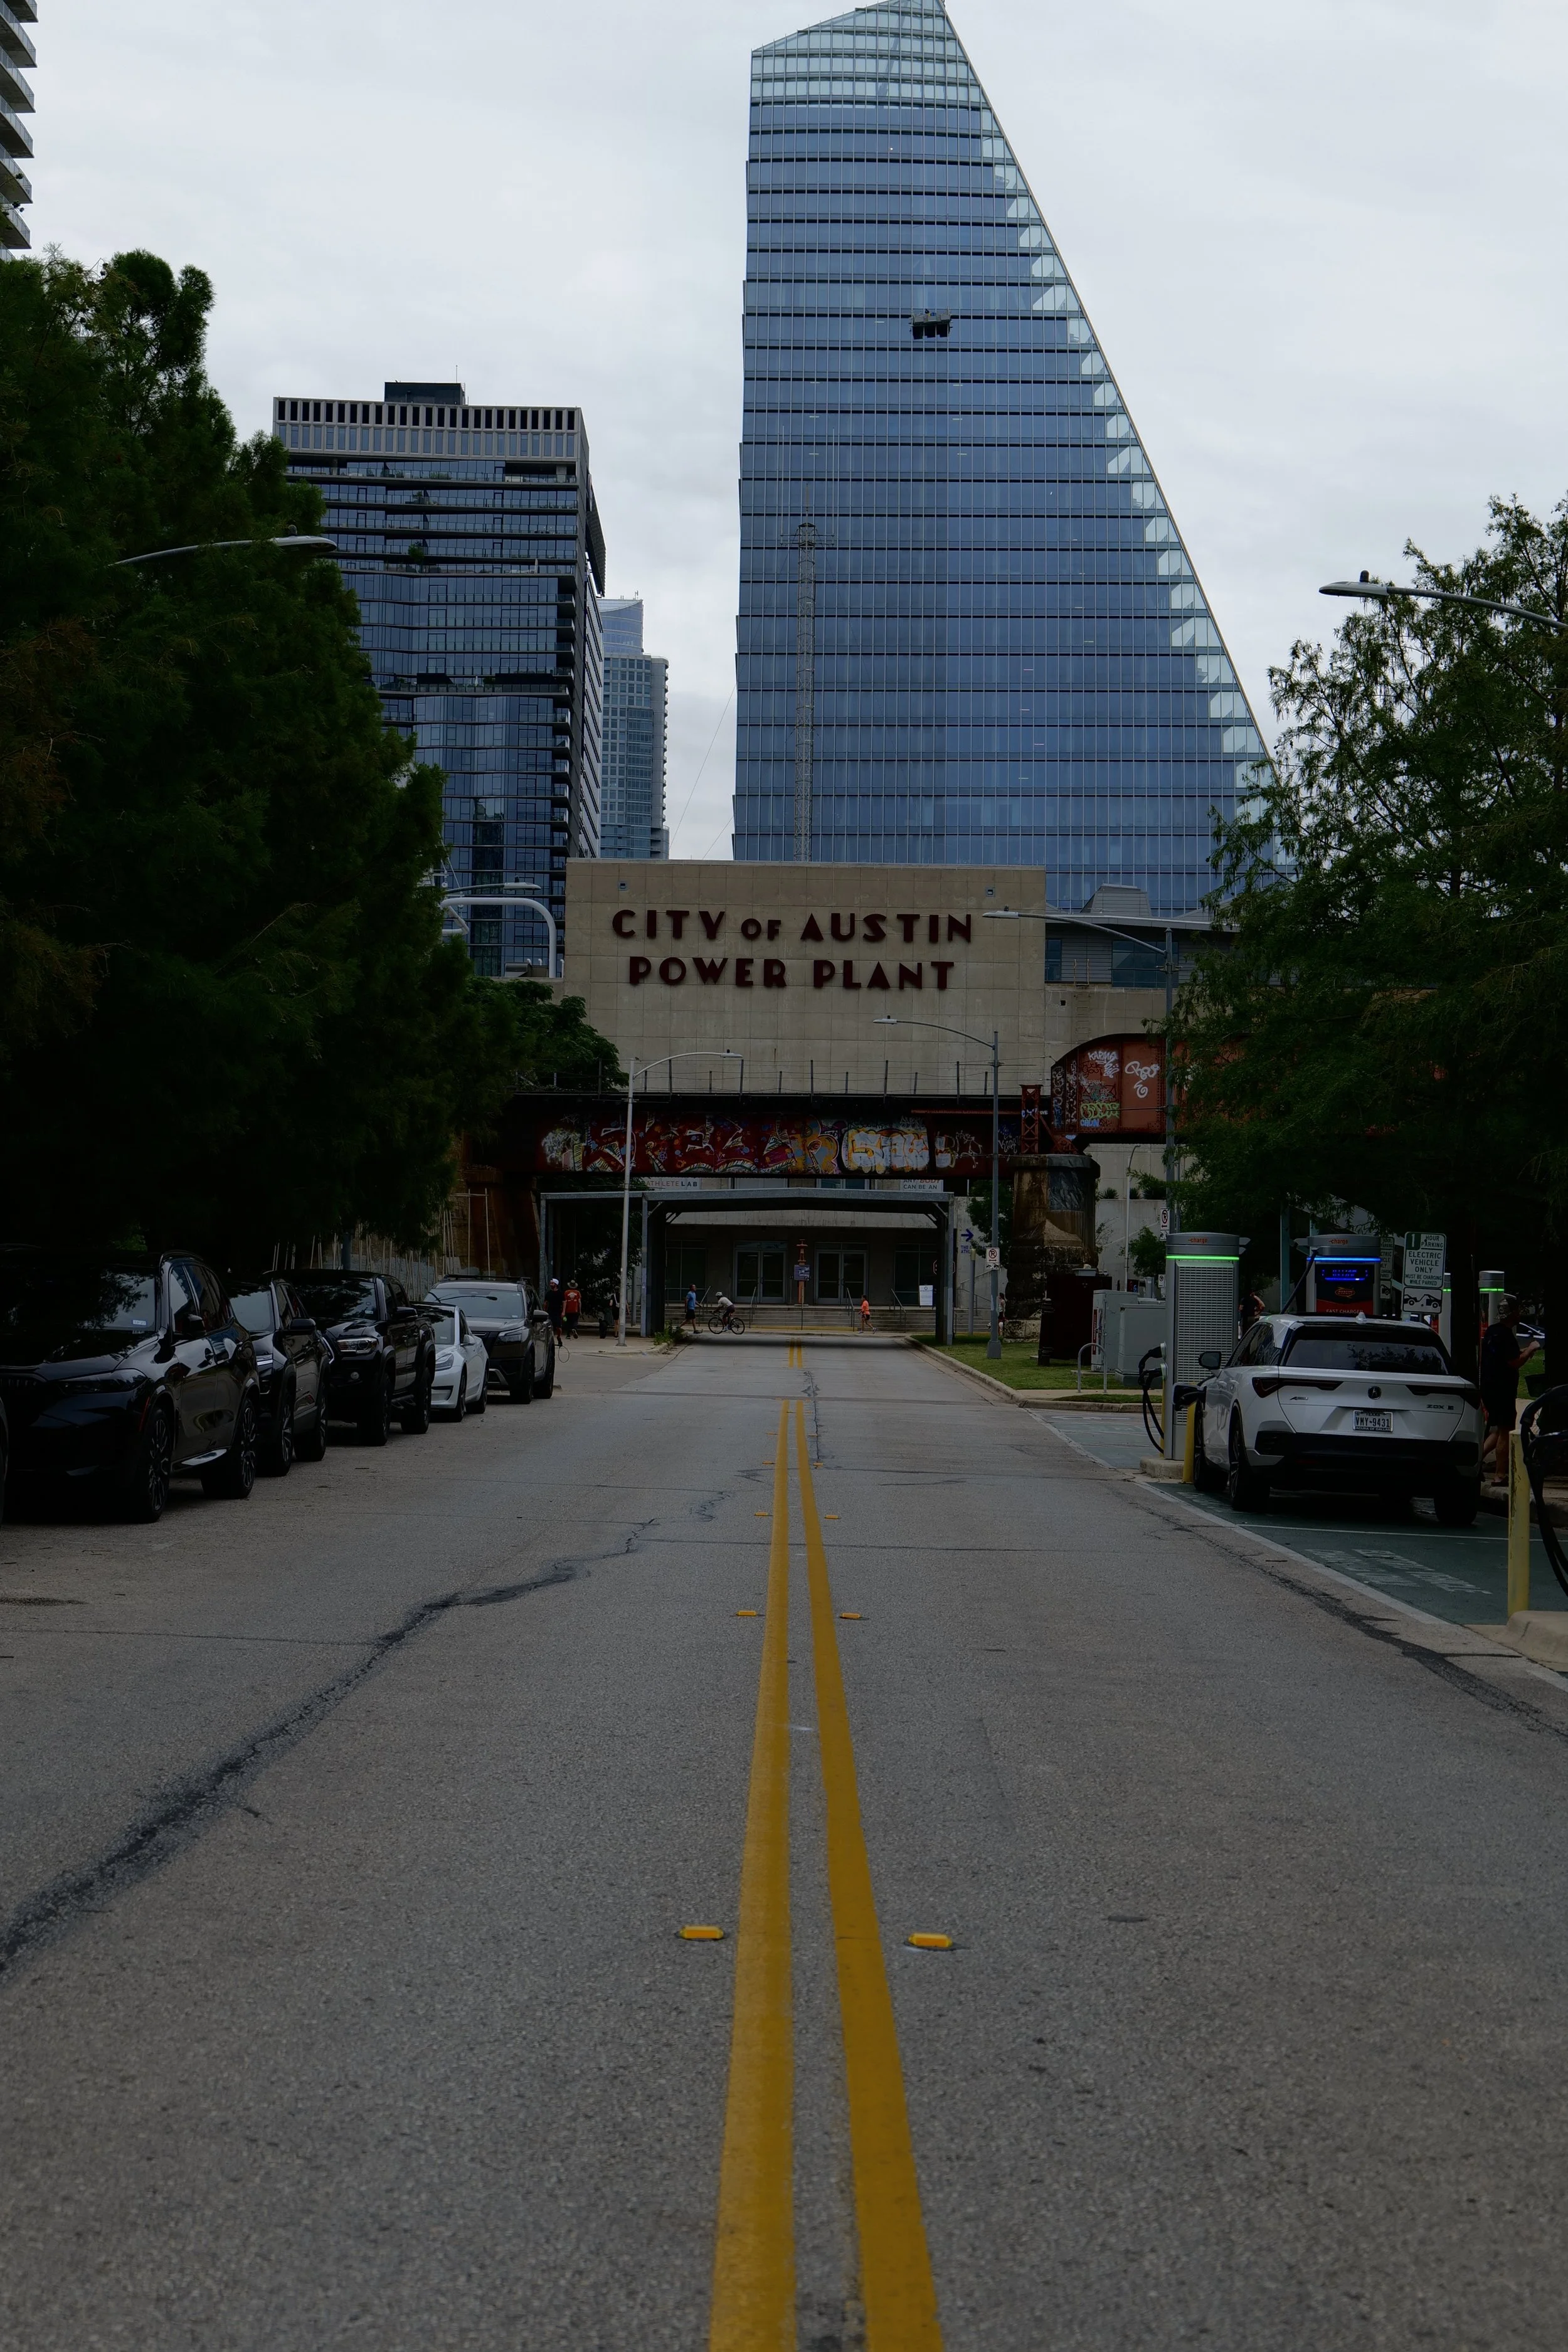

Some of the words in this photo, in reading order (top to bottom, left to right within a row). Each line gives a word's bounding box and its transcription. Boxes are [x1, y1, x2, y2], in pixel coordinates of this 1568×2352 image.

[612, 909, 724, 939] CITY
[741, 918, 781, 940] OF
[800, 913, 971, 942] AUSTIN
[630, 956, 787, 987] POWER
[813, 960, 954, 989] PLANT
[1411, 1233, 1416, 1248] 1
[1409, 1251, 1441, 1259] ELECTRIC
[1410, 1258, 1439, 1266] VEHICLE
